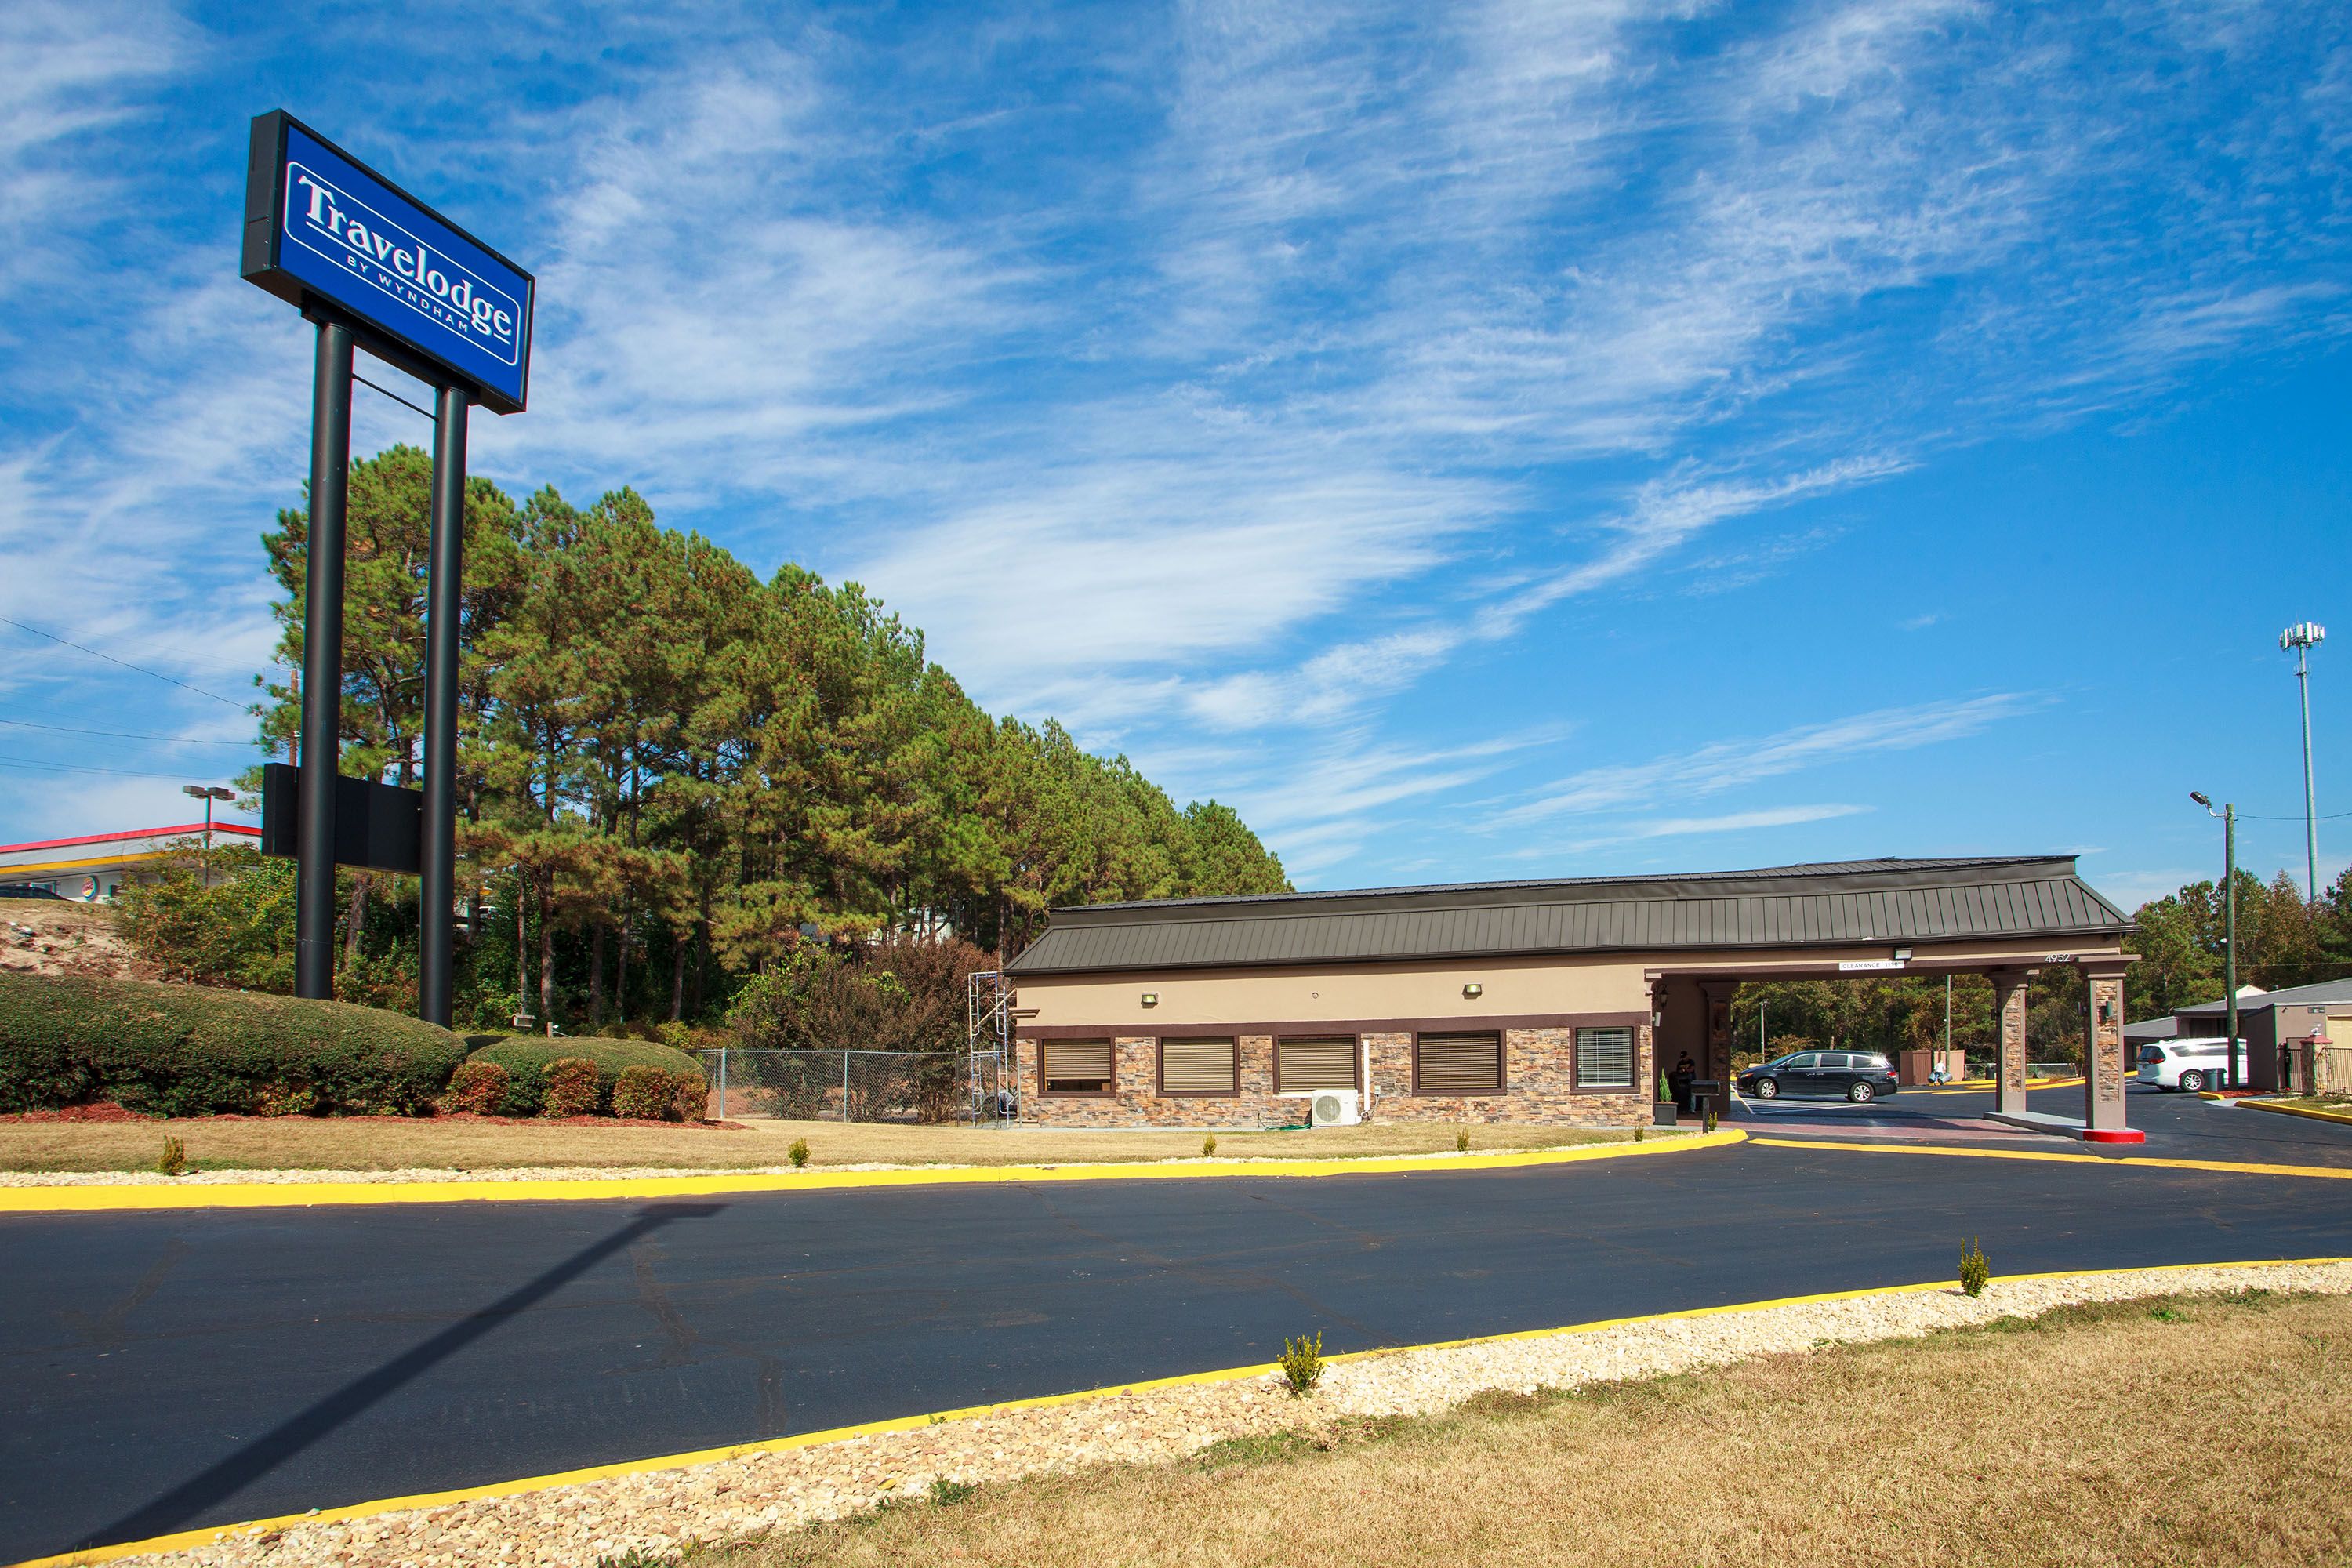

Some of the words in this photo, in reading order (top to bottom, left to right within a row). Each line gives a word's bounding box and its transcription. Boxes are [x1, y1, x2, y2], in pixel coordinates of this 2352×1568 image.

[298, 175, 513, 336] Travelodge
[347, 255, 369, 273] BY
[378, 273, 468, 332] WYNDHAM
[2045, 953, 2071, 963] 4952
